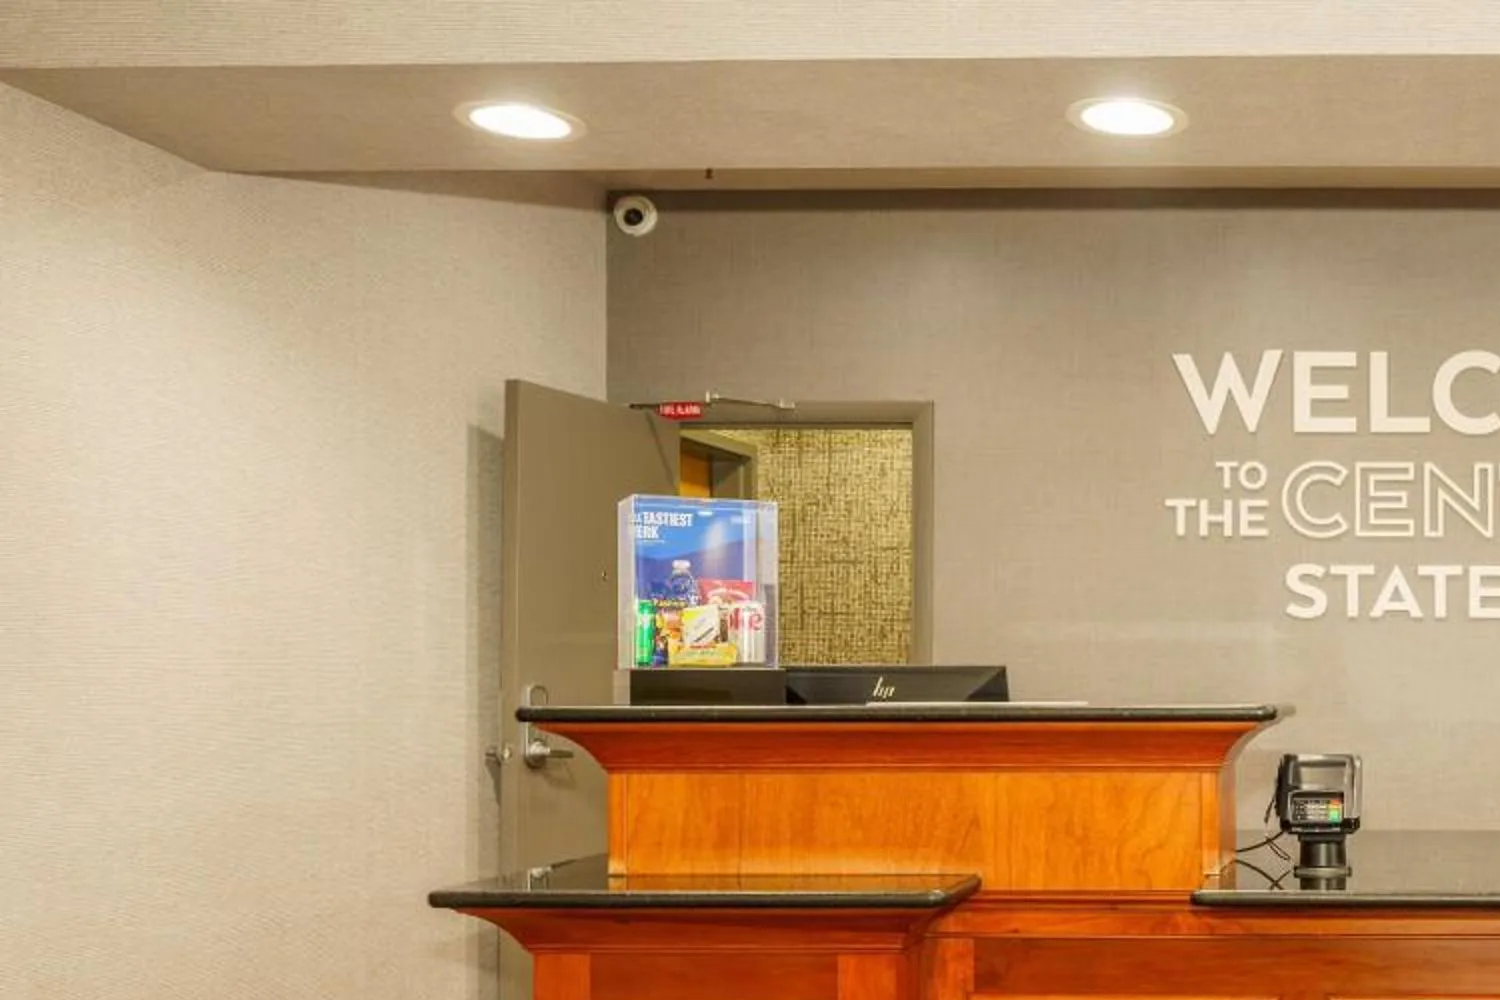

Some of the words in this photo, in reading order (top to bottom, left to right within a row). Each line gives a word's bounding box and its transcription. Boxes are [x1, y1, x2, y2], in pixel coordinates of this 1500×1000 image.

[1215, 460, 1268, 491] TO
[1165, 498, 1270, 537] THE
[873, 676, 895, 699] hp
